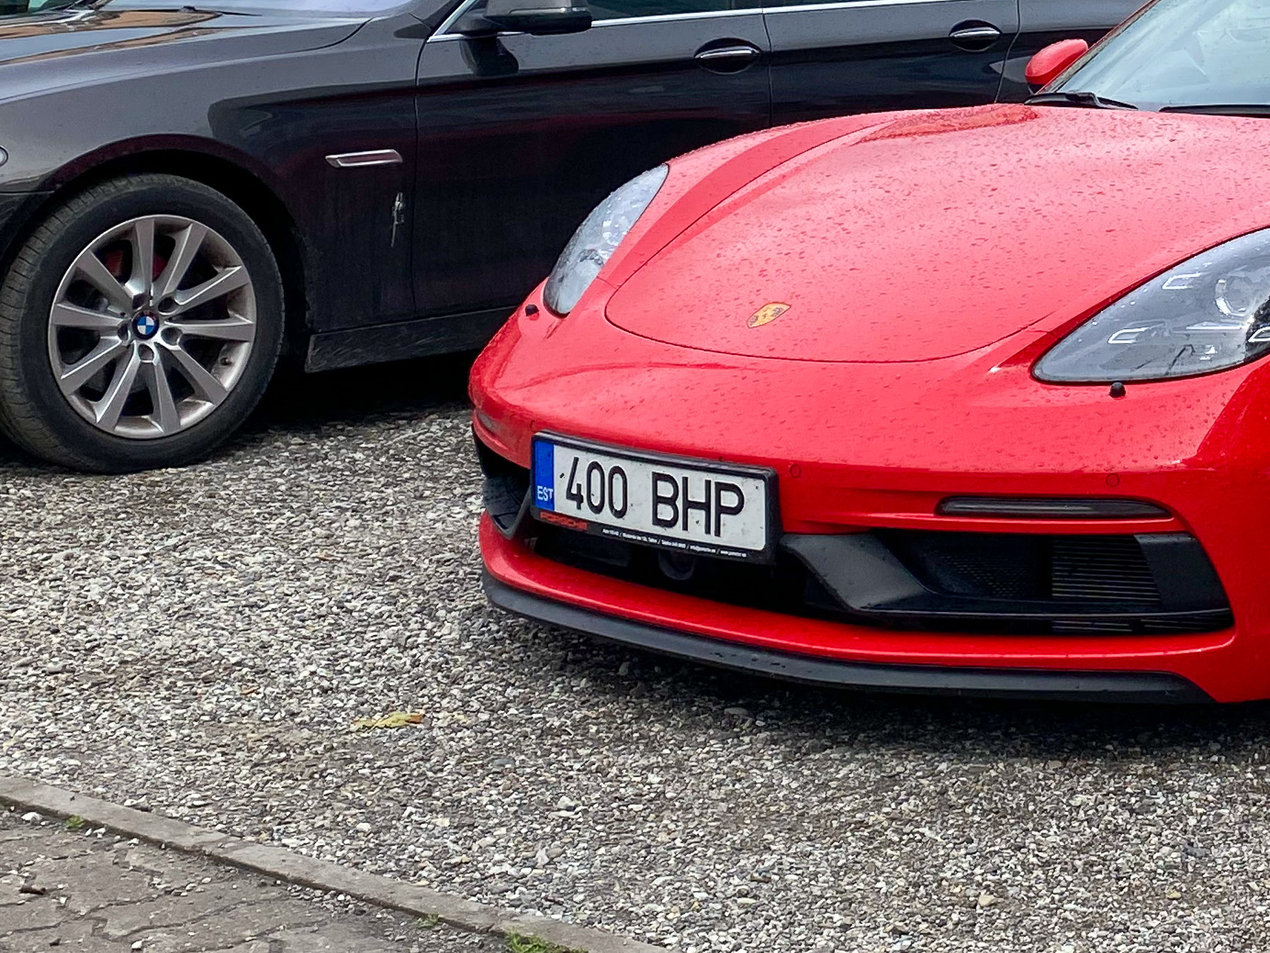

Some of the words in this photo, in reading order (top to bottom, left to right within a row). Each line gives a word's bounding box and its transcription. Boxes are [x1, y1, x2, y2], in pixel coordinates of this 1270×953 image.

[537, 485, 554, 502] EST
[565, 456, 629, 519] 400
[651, 470, 745, 538] BHP
